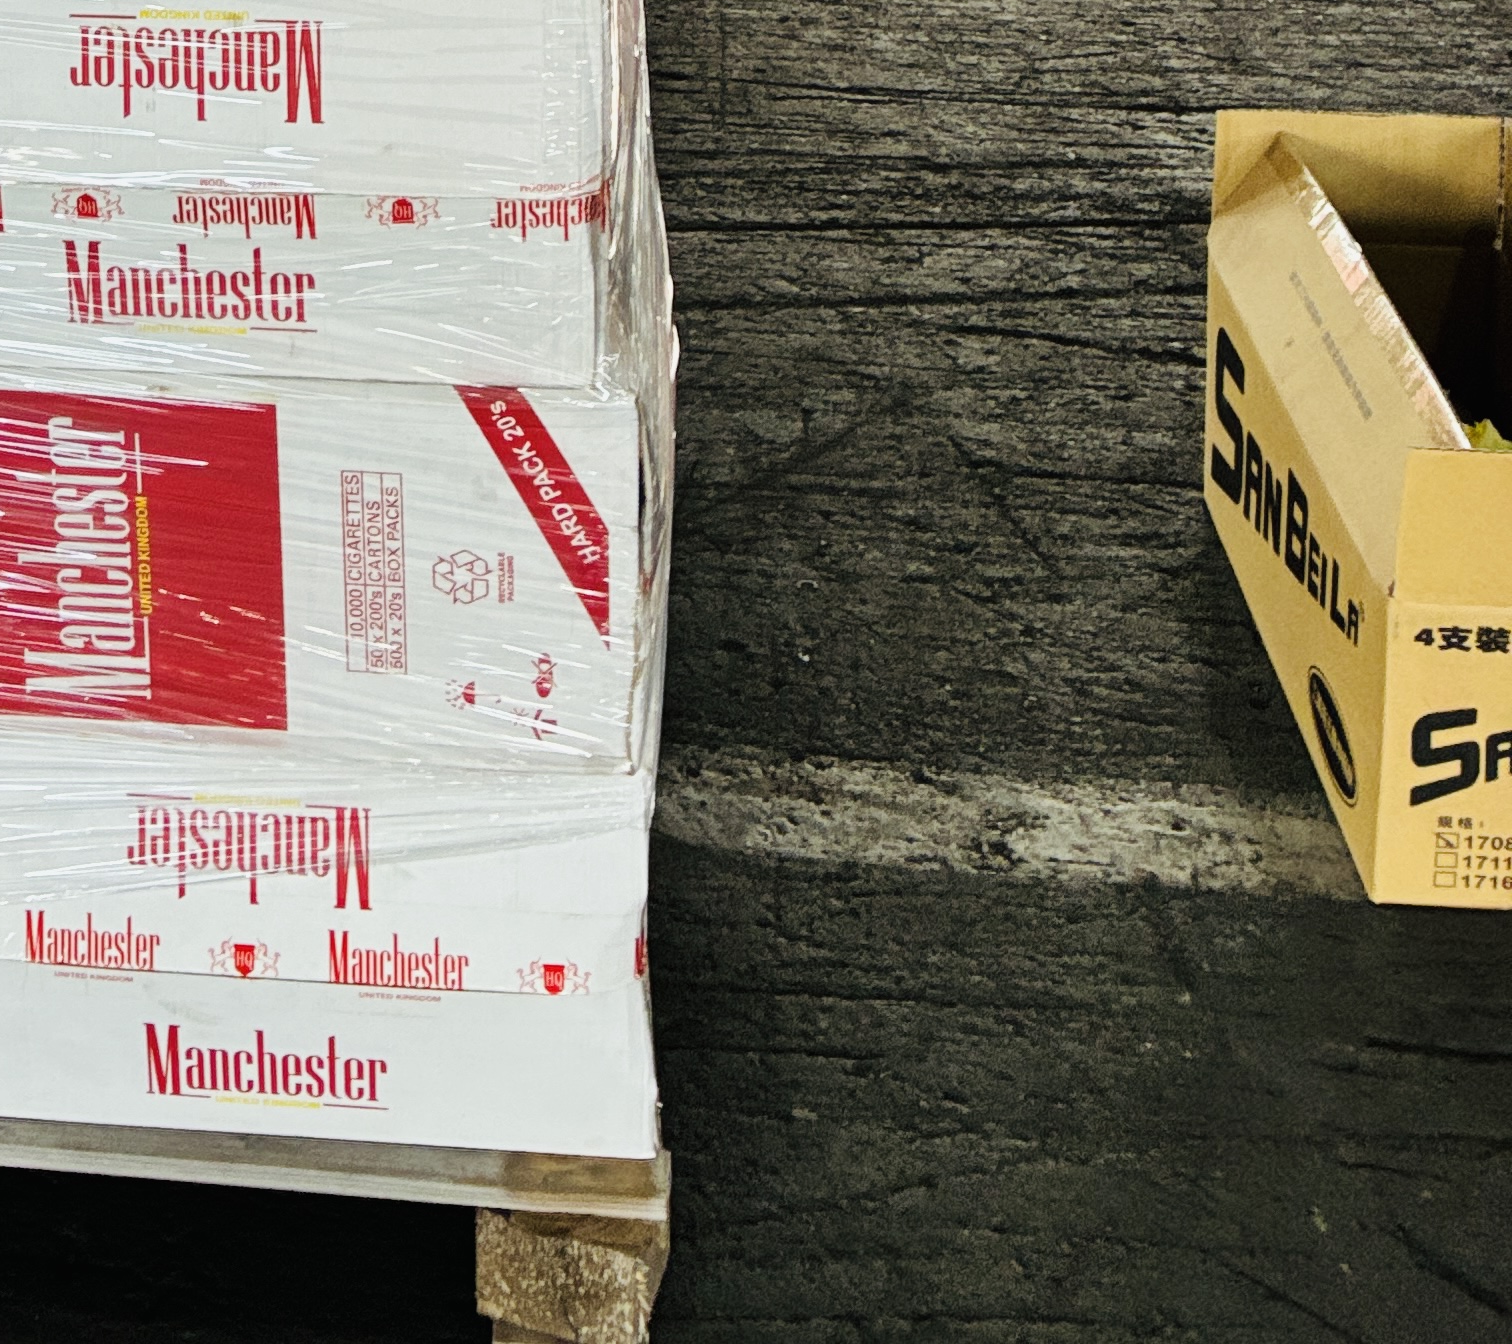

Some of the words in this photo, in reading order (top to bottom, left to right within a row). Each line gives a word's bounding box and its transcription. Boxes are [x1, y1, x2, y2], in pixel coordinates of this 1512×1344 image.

[139, 9, 200, 21] KINGDOM
[70, 18, 325, 124] Manchester
[172, 194, 318, 241] Manchester
[65, 239, 317, 325] Manchester
[490, 399, 524, 443] 20's
[512, 442, 563, 503] PACK
[134, 494, 150, 564] KINGDOM
[345, 474, 363, 582] CIGARETTES
[385, 486, 400, 542] PACKS
[551, 501, 601, 565] HARD
[15, 415, 152, 701] Manchester
[366, 500, 383, 583] CARTONS
[387, 546, 401, 583] BOX
[138, 564, 153, 616] UNITED
[350, 588, 365, 638] 10,000
[369, 590, 385, 632] 200's
[389, 592, 403, 622] 20's
[392, 627, 402, 637] x
[1413, 625, 1511, 654] 4支裝
[125, 805, 373, 911] Manchester
[24, 909, 161, 972] Manchester
[237, 951, 254, 970] HQ
[328, 929, 469, 992] Manchester
[89, 973, 134, 983] KINGDOM
[358, 991, 393, 1000] UNITED
[395, 993, 441, 1002] KINGDOM
[545, 969, 565, 991] HQ
[144, 1022, 389, 1104] Manchester
